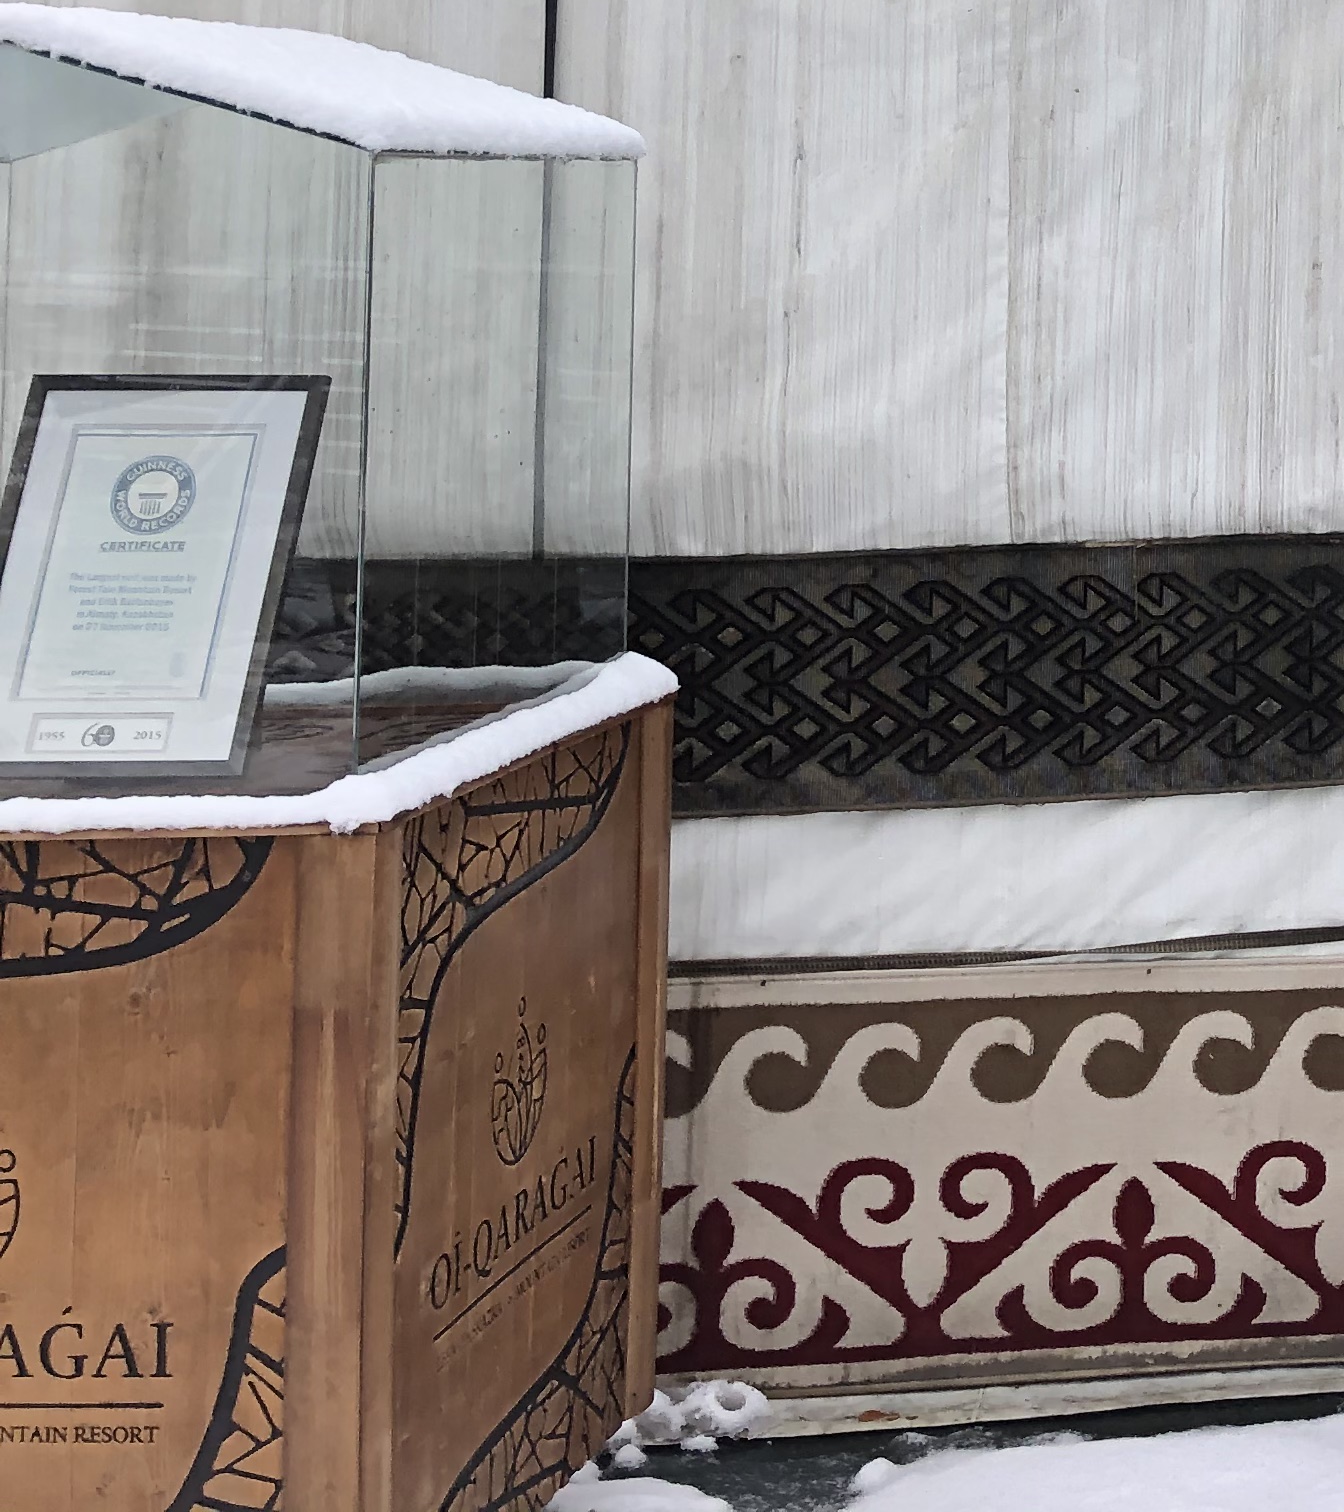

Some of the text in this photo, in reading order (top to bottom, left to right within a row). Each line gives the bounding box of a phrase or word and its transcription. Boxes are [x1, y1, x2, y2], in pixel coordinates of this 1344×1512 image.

[126, 460, 189, 481] GUINNESS
[115, 489, 191, 531] WORLD RECORDS
[100, 540, 186, 553] CERTIFICATE
[133, 730, 162, 740] 2015
[73, 1425, 160, 1444] RESORT
